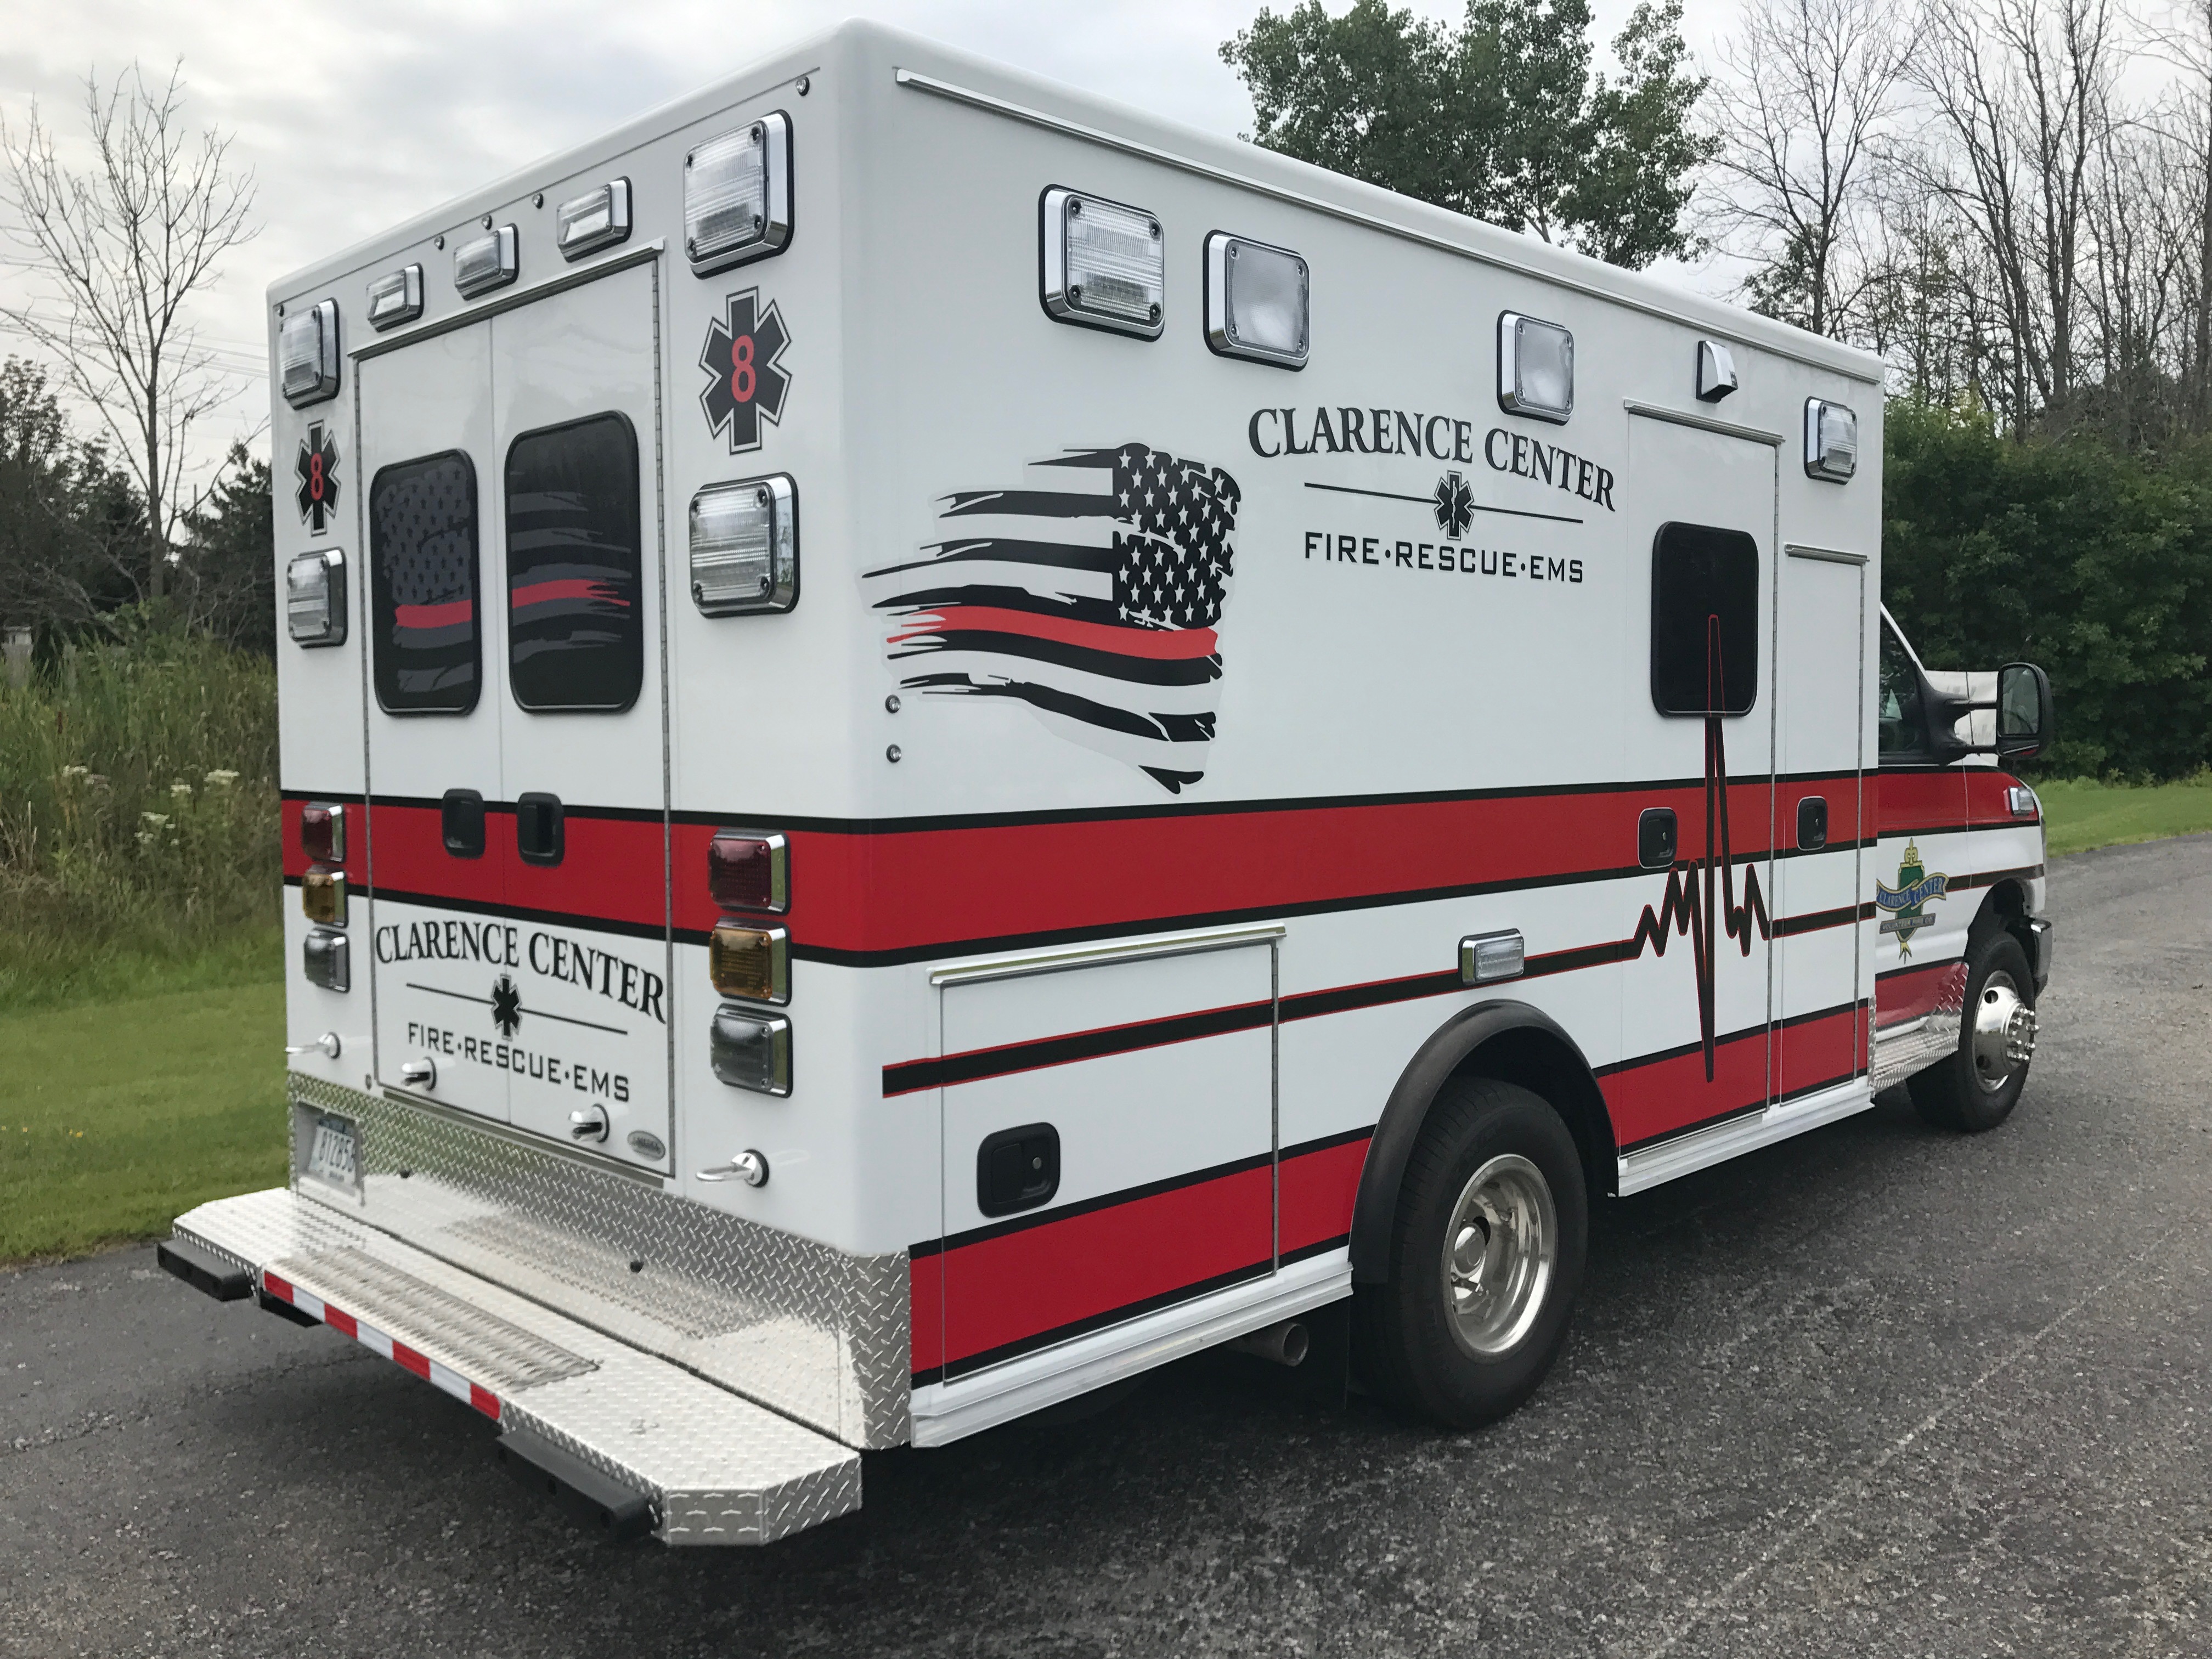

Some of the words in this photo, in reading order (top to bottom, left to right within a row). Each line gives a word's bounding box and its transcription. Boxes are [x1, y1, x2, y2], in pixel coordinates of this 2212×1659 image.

[731, 334, 757, 403] 8
[311, 452, 324, 501] 8
[1248, 407, 1474, 464] CLARENCE
[1484, 428, 1616, 512] CENTER
[1879, 889, 1911, 907] CLARENCE
[1914, 877, 1943, 904] CENTER
[375, 921, 520, 968] CLARENCE
[528, 931, 667, 1025] CENTER
